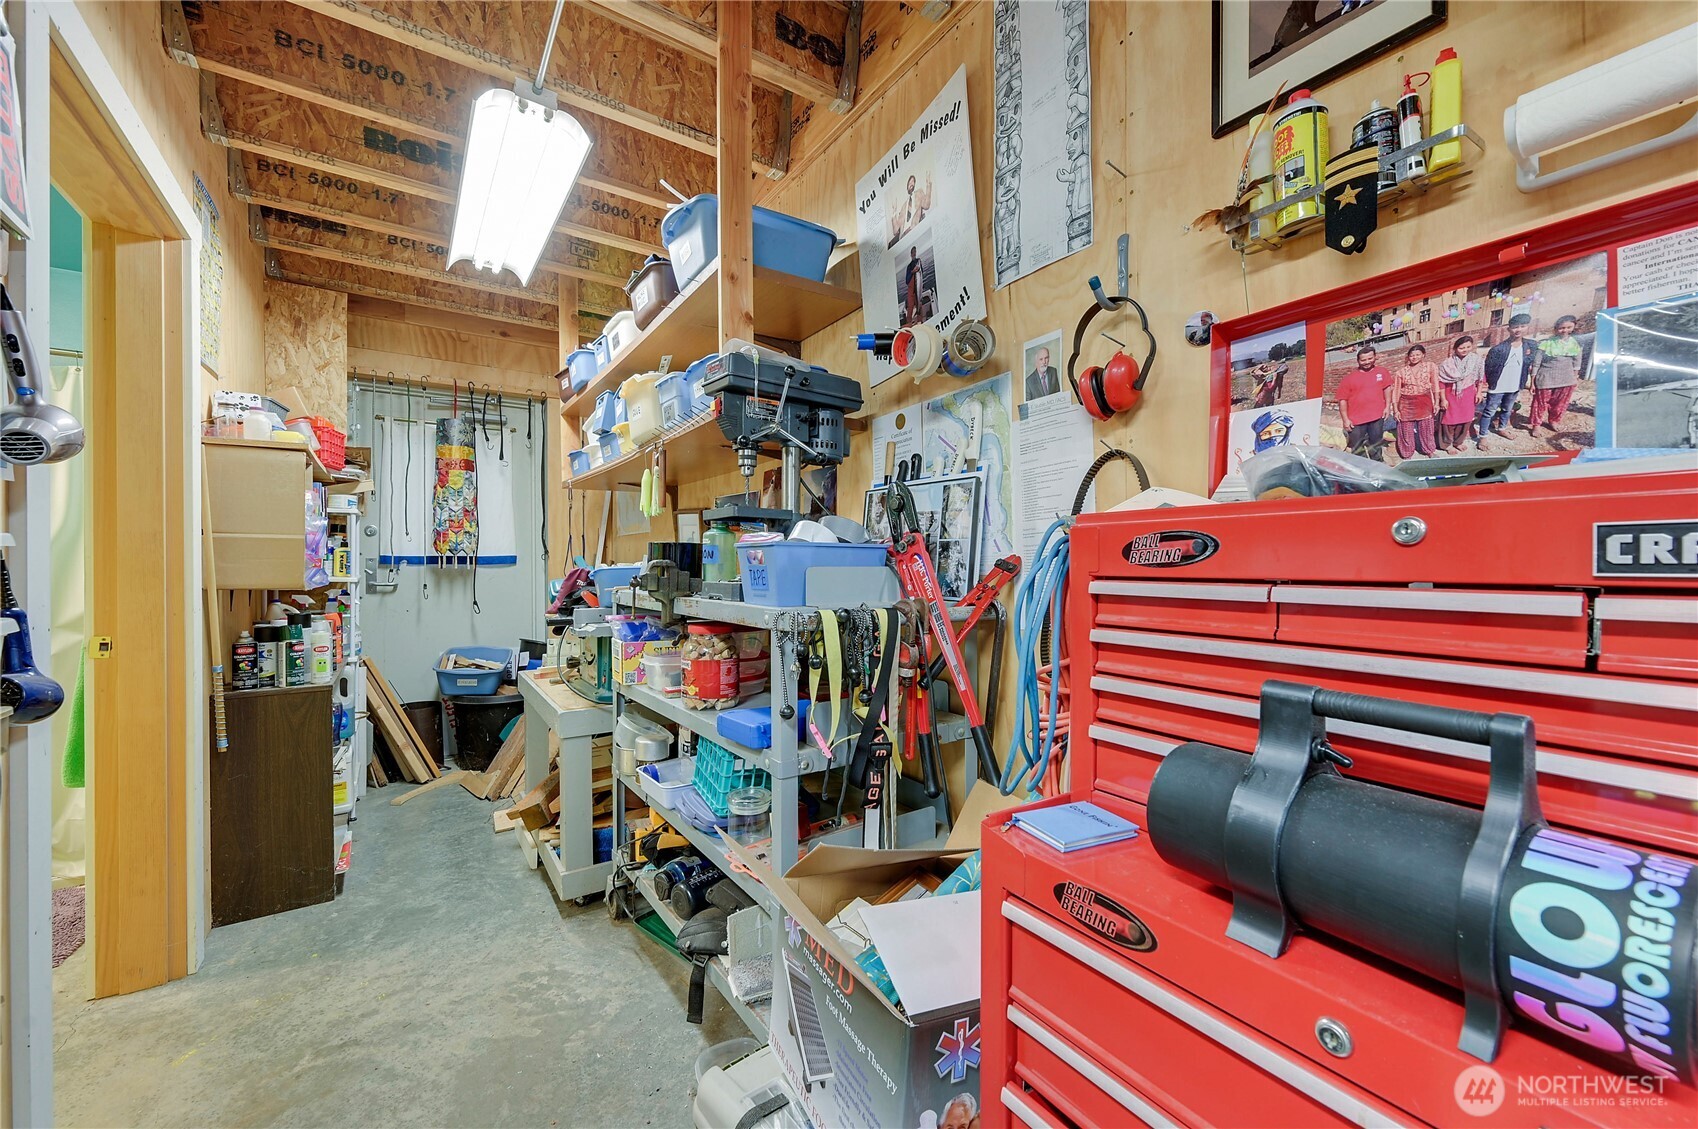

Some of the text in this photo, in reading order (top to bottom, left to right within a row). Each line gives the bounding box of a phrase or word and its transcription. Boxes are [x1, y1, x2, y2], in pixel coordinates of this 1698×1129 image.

[342, 53, 407, 87] 5000
[370, 8, 433, 40] CCMC
[657, 116, 704, 142] WHITE
[859, 190, 877, 215] You
[878, 155, 899, 187] Will
[903, 141, 916, 160] Be
[920, 100, 962, 144] Missed!
[307, 172, 359, 194] 5000
[591, 199, 631, 220] 5000
[1622, 241, 1654, 254] Captain
[1655, 236, 1673, 245] Don
[1622, 246, 1661, 261] donations
[1663, 242, 1676, 250] for
[1622, 257, 1649, 268] cancer
[1650, 252, 1665, 260] and
[1644, 268, 1663, 277] cash
[1676, 259, 1698, 269] chec
[1622, 273, 1670, 289] appreciated.
[1622, 277, 1691, 296] better fisherman.
[1131, 533, 1161, 550] BALL
[1129, 547, 1182, 565] BEARING
[748, 569, 767, 586] TAPE
[922, 576, 935, 600] Porter
[1064, 880, 1096, 907] BALL
[1060, 895, 1117, 938] BEARING
[1509, 829, 1642, 1053] GLOW
[803, 946, 853, 1014] massager.com
[825, 994, 898, 1095] Foot Massage Therapy
[771, 1032, 812, 1111] THERAPEUTIC
